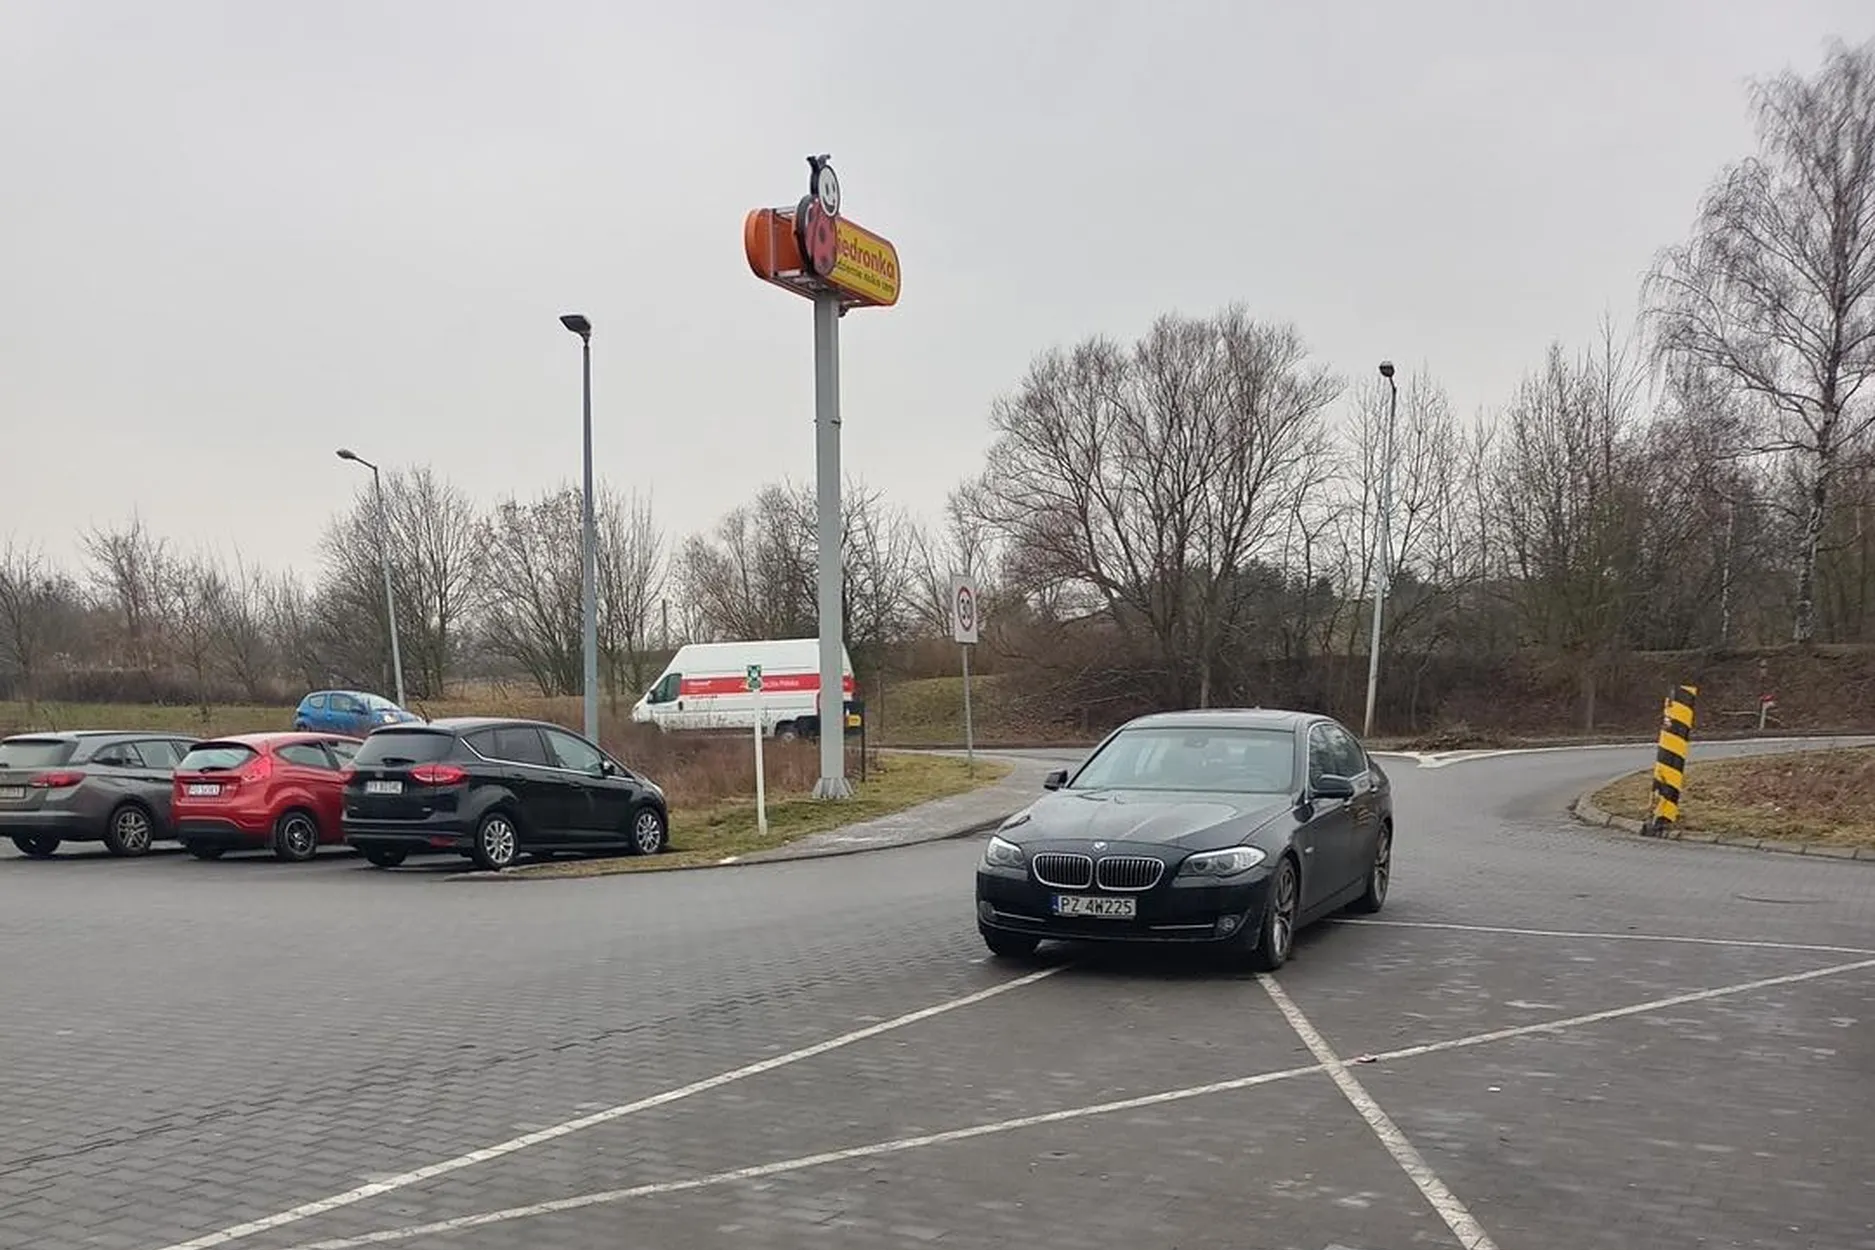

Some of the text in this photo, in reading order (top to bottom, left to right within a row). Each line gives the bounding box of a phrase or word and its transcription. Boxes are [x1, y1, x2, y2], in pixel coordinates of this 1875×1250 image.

[837, 231, 895, 279] iedronka
[1061, 897, 1132, 914] PZ 4W225
